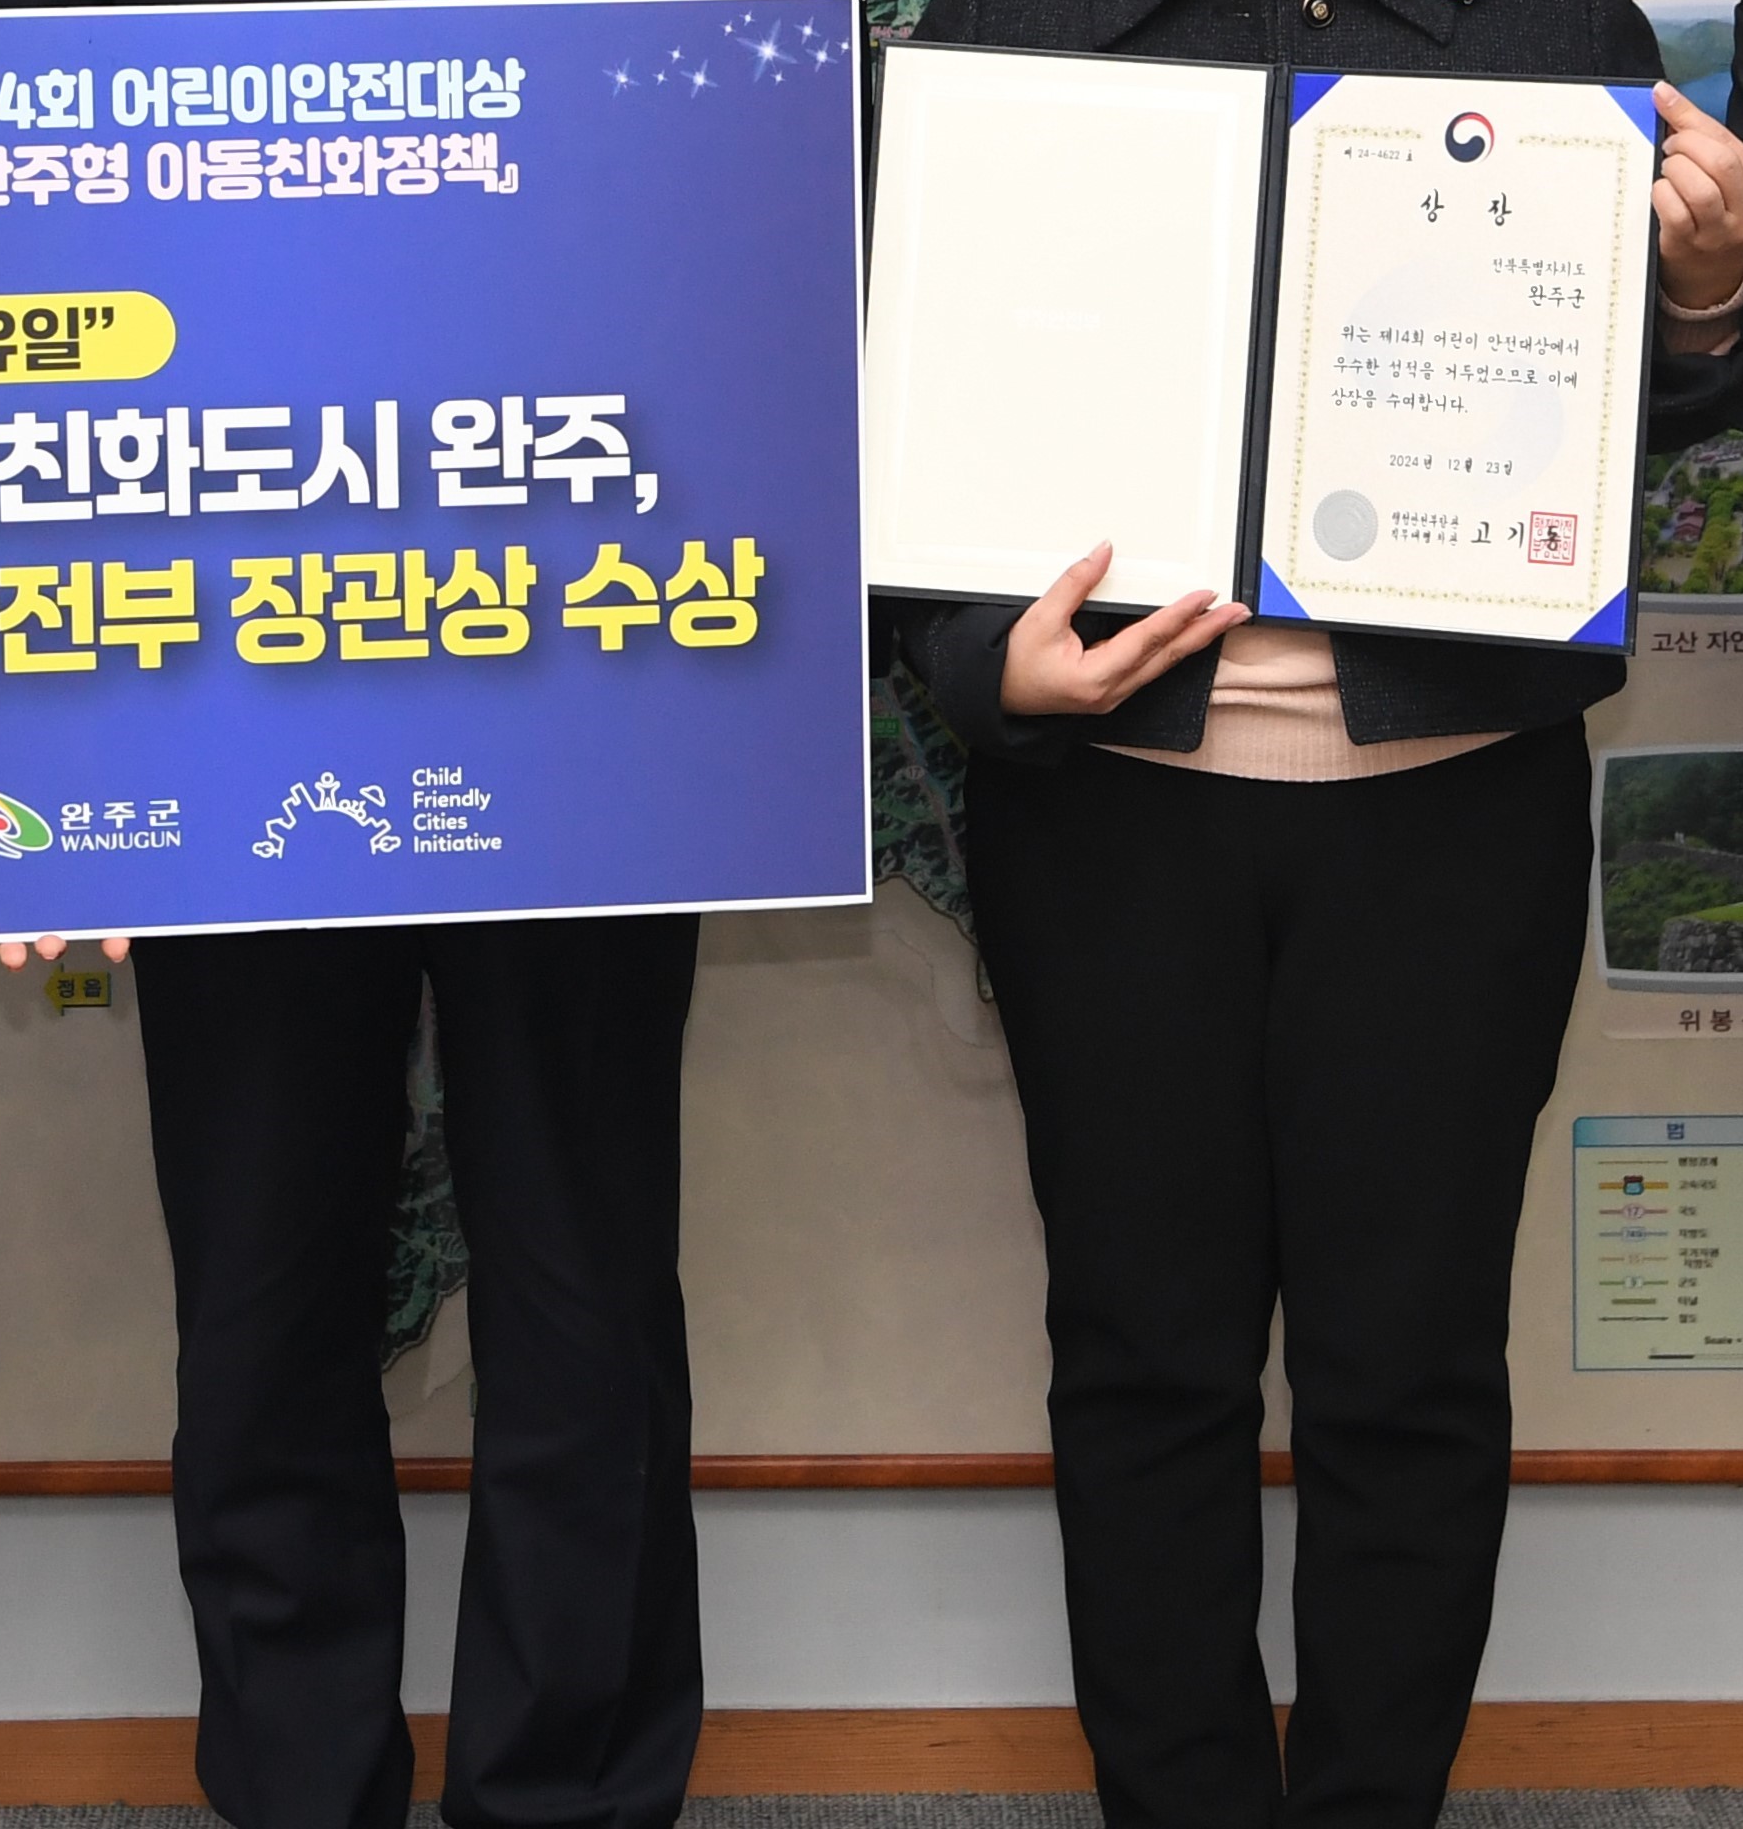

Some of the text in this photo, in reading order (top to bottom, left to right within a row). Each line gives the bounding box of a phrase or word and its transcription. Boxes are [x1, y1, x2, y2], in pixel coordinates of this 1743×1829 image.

[112, 58, 526, 127] 어린이안전대상
[1529, 285, 1585, 309] 완주군
[1341, 325, 1579, 356] 위는 제14회 어린이 안전대상에서
[1334, 357, 1577, 388] 우수한 성적을 거두었으므로 이에
[1332, 388, 1376, 408] 상장을
[431, 395, 657, 514] 완주,
[231, 546, 536, 663] 장관상
[563, 538, 764, 650] 수상
[1651, 631, 1698, 653] 고산
[412, 767, 462, 786] Child
[413, 788, 491, 811] Friendly
[60, 800, 179, 830] 완주군
[413, 812, 467, 831] Cities
[61, 831, 180, 852] WANJUGUN
[414, 833, 502, 853] Initiative
